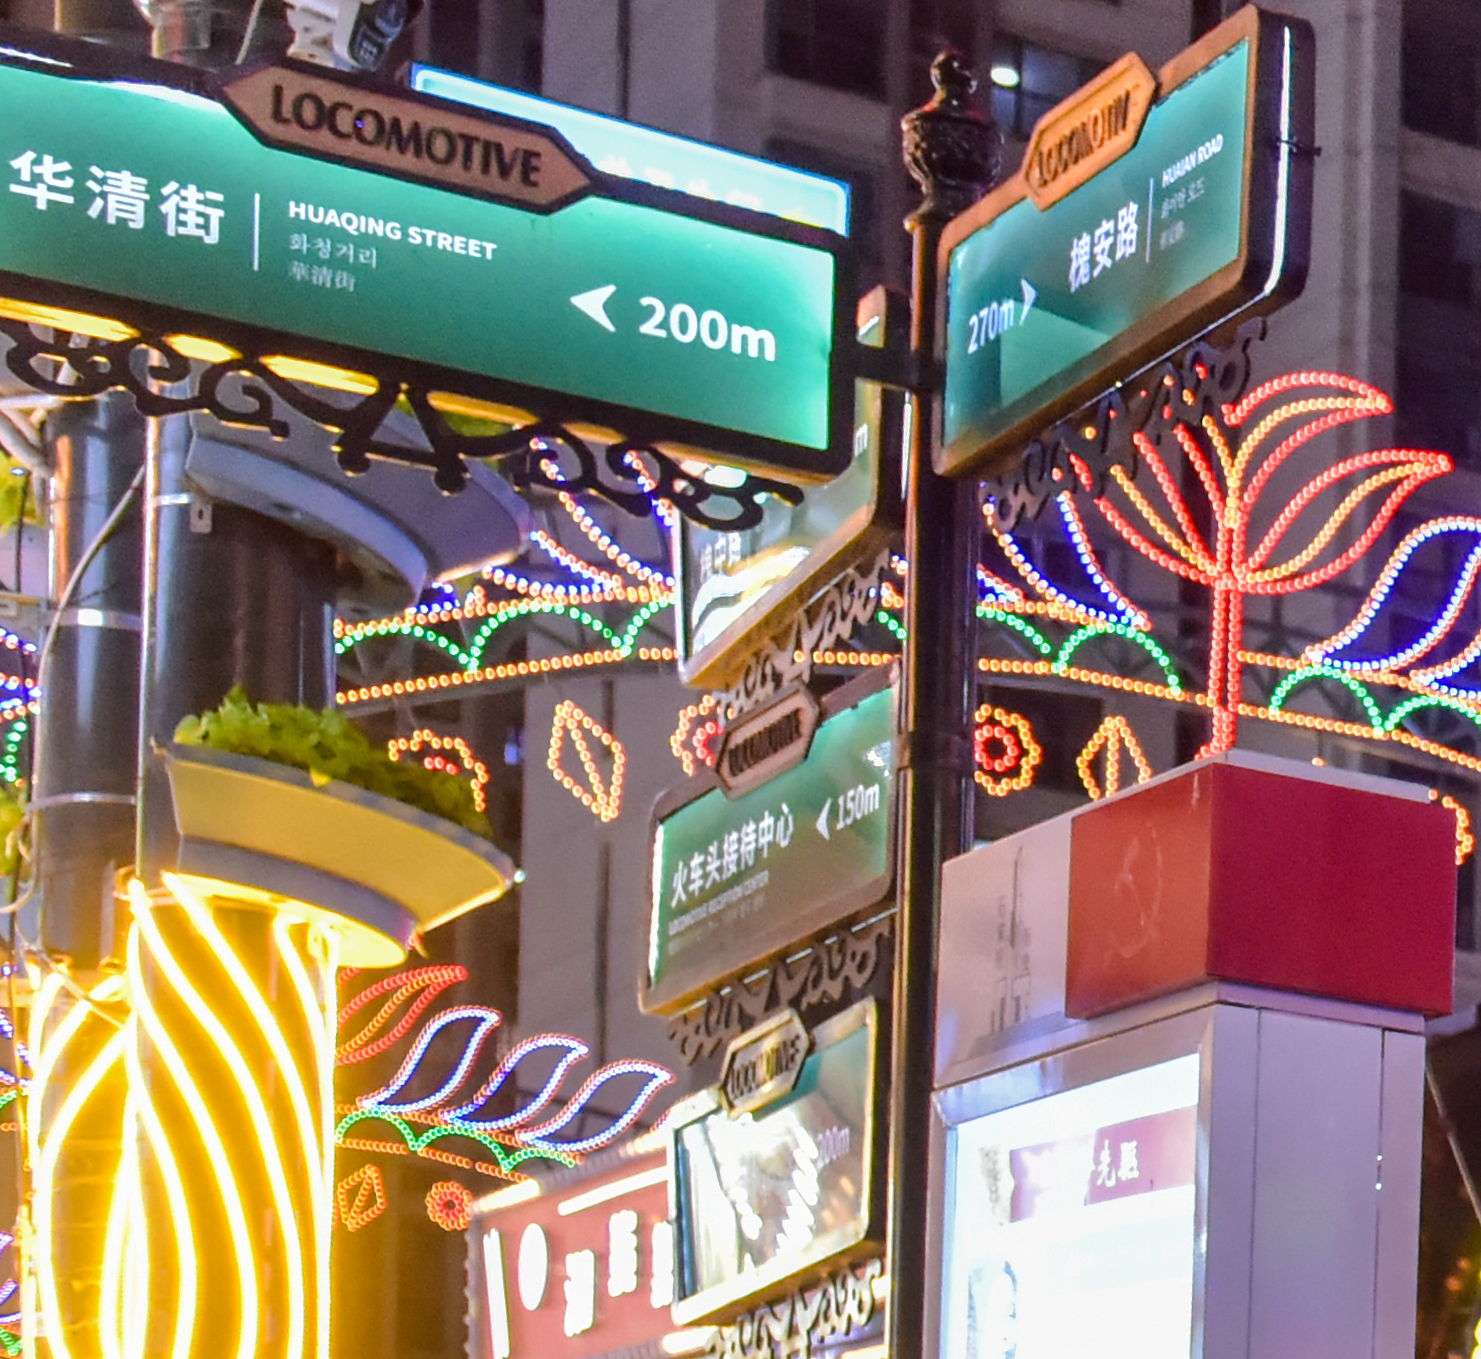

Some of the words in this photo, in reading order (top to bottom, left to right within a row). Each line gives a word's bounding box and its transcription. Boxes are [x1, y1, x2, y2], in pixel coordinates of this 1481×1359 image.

[271, 83, 542, 189] LOCOMOTIVE
[9, 149, 226, 245] 华清街
[288, 199, 402, 241] HUAQING
[407, 226, 497, 261] STREET
[1069, 201, 1139, 293] 槐安路
[638, 295, 777, 362] 200m
[967, 298, 1016, 355] 270m
[836, 782, 880, 831] 150m
[671, 802, 795, 909] 火车头接待中心
